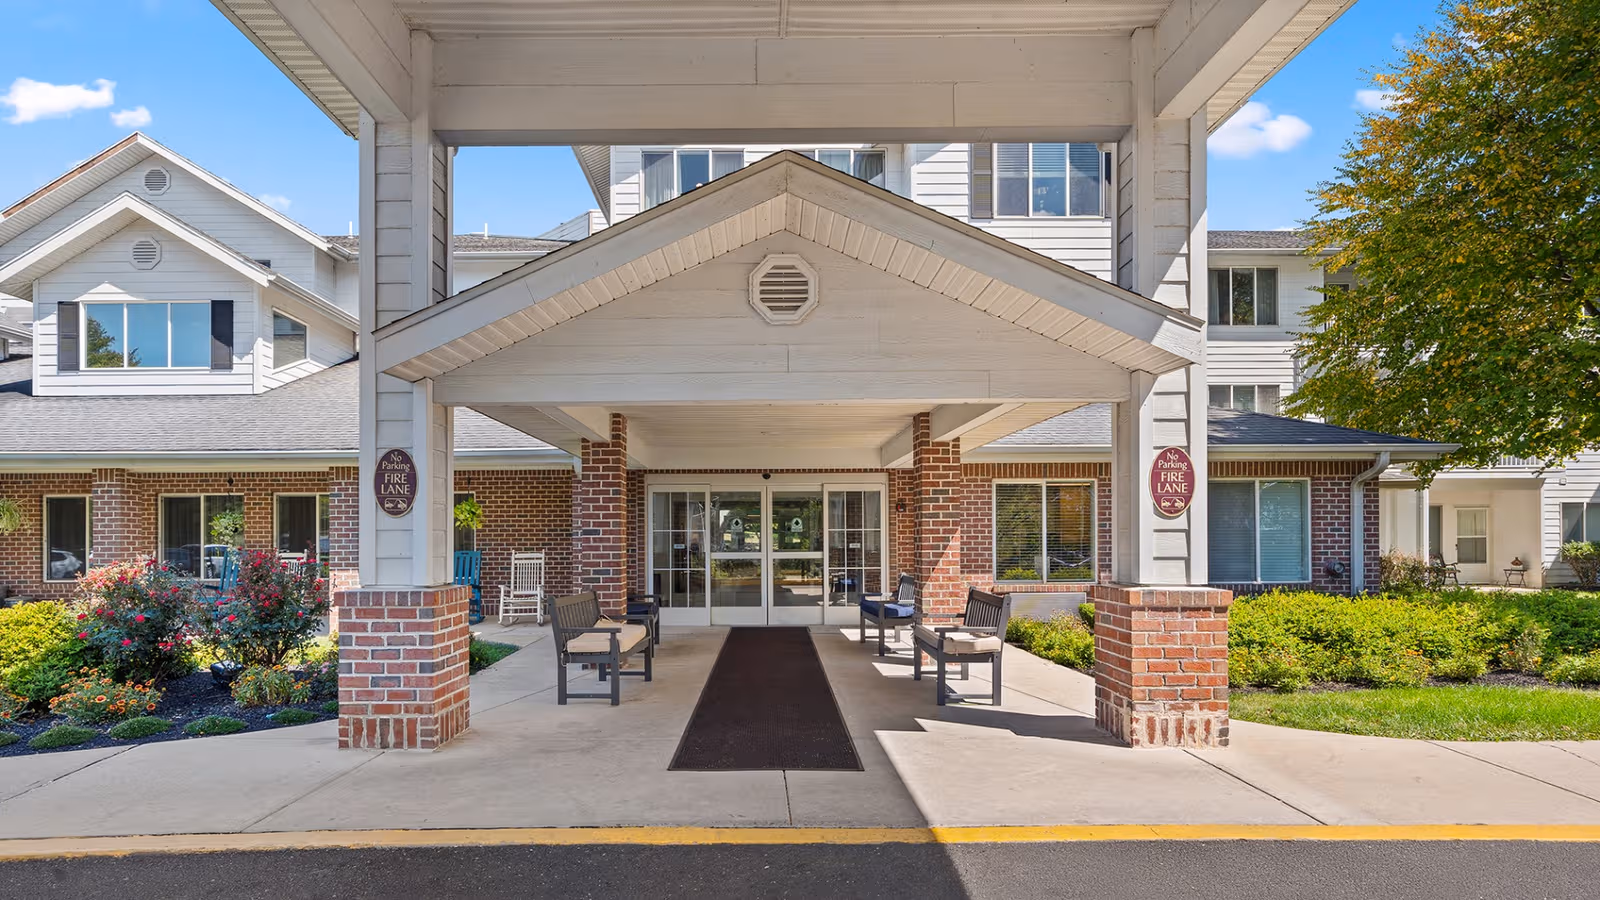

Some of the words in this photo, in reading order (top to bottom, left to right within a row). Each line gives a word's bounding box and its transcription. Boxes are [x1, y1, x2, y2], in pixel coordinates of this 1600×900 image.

[390, 453, 402, 461] No
[1166, 451, 1179, 460] No
[382, 461, 410, 472] Parking
[1158, 460, 1188, 470] Parking
[384, 473, 407, 484] FIRE
[1161, 471, 1185, 482] FIRE
[381, 484, 410, 494] LANE
[1157, 482, 1188, 493] LANE
